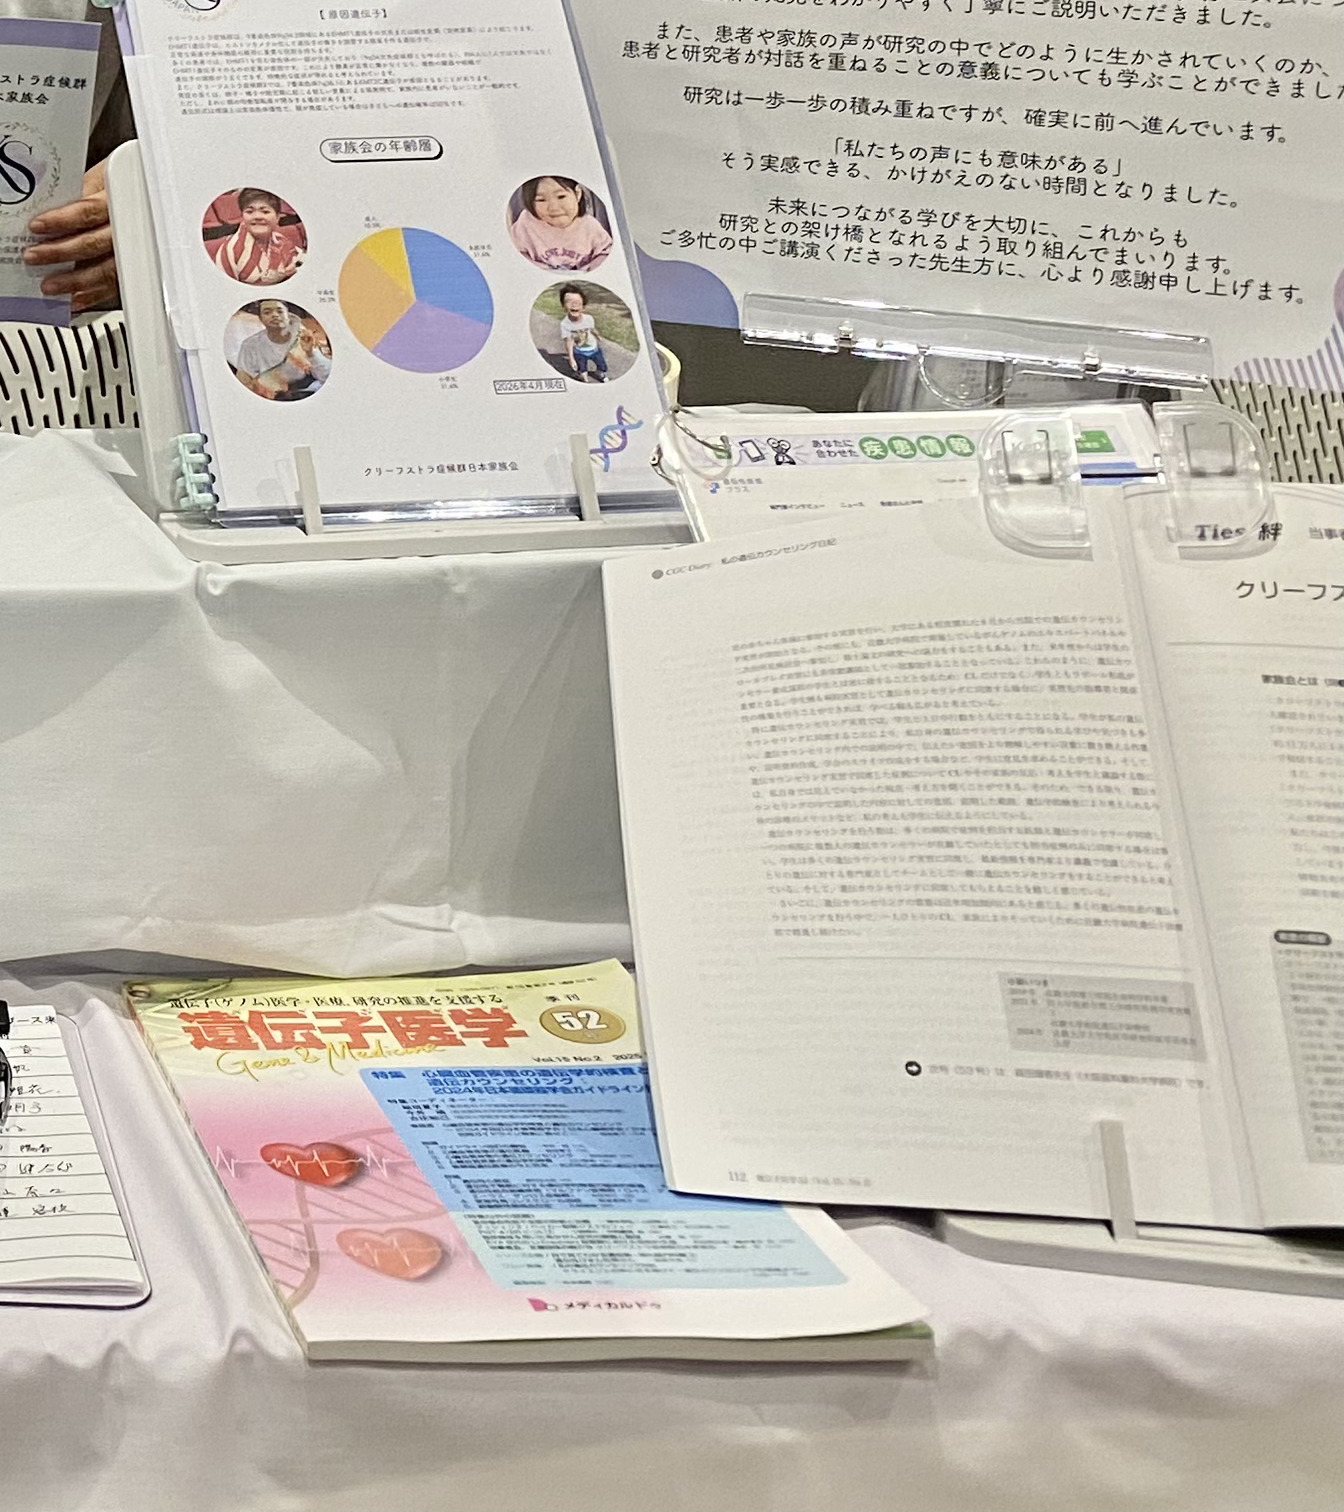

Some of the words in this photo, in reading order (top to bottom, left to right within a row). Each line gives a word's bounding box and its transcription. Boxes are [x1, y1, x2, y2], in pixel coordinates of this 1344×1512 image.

[328, 138, 433, 156] 家族会の年齢層
[1195, 523, 1245, 541] Ties
[182, 1007, 530, 1052] 遺伝子医学
[552, 1010, 608, 1031] 52
